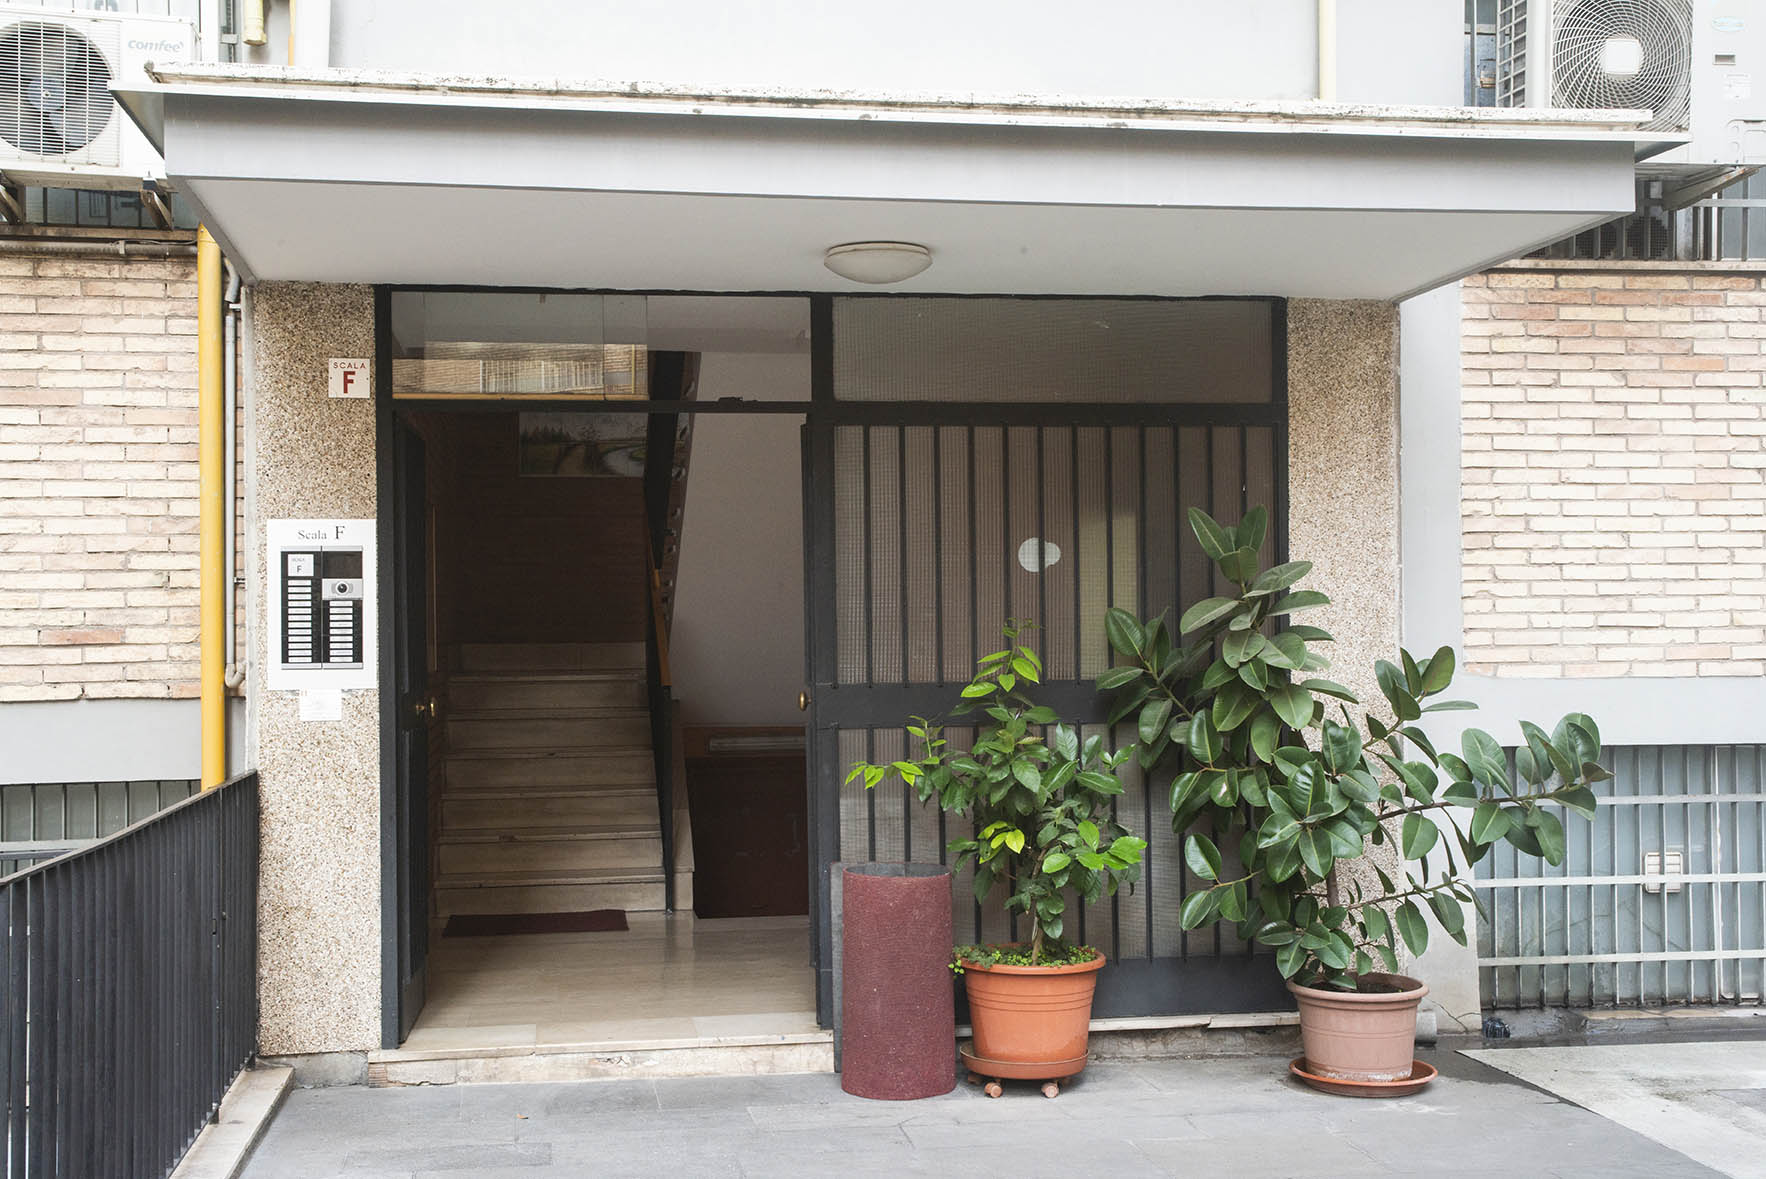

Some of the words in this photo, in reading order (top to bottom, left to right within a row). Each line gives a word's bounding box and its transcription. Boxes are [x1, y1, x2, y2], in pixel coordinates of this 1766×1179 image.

[343, 371, 355, 393] F
[297, 530, 327, 540] Scala
[336, 526, 345, 539] F
